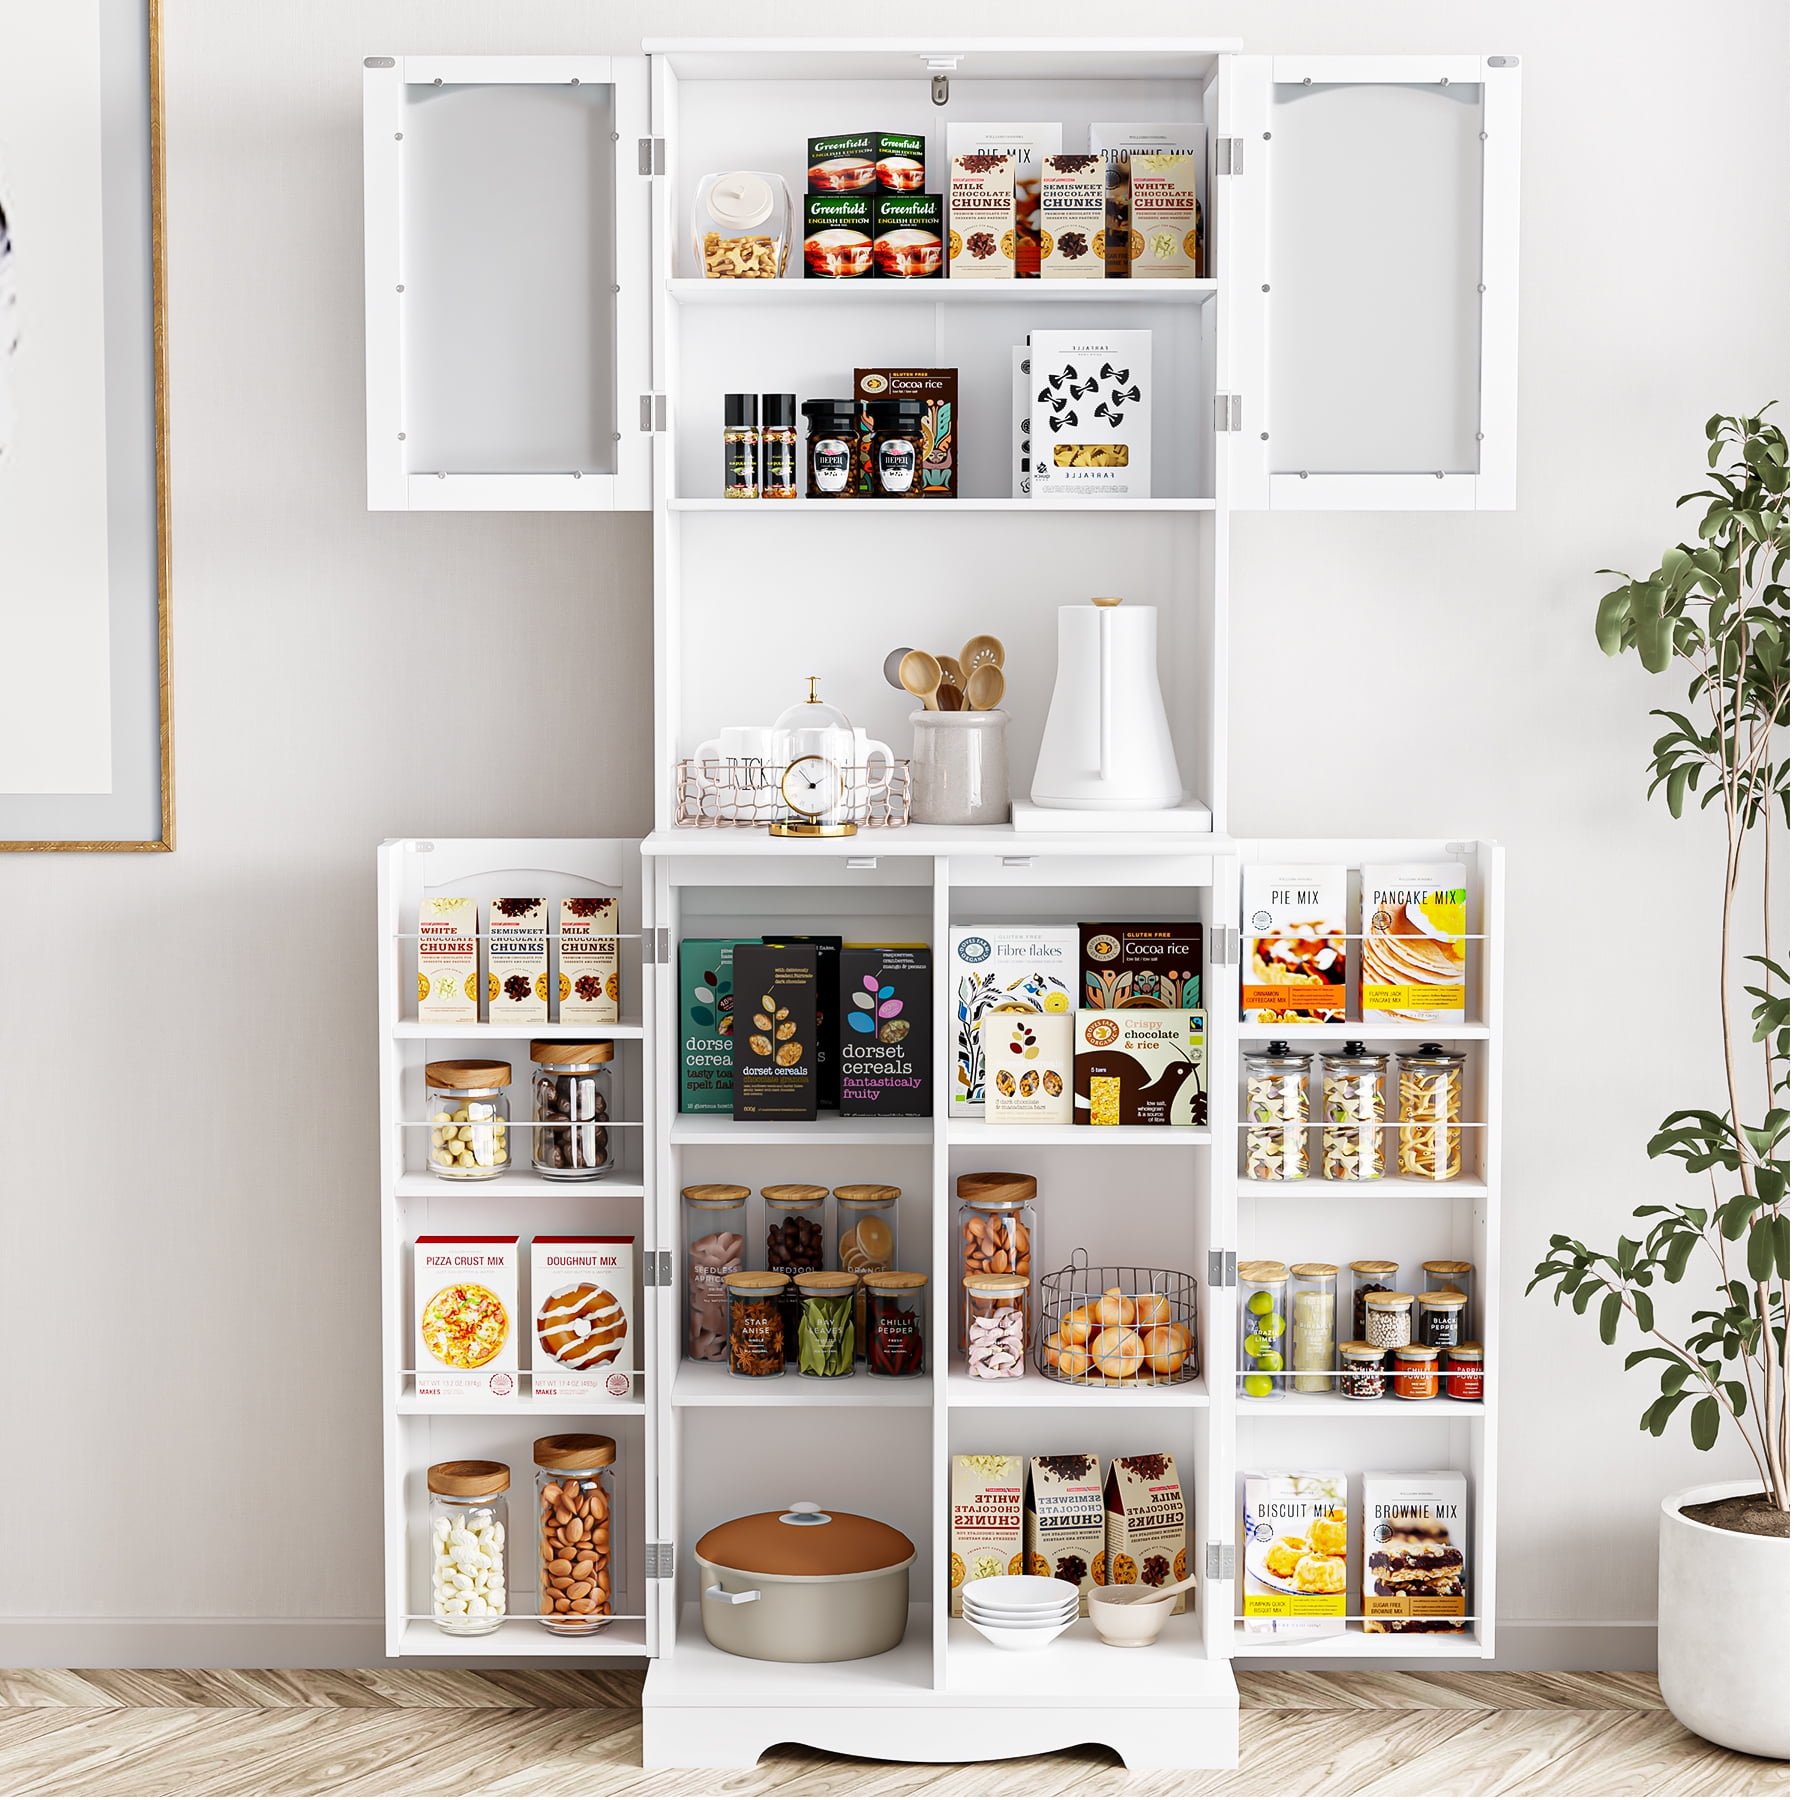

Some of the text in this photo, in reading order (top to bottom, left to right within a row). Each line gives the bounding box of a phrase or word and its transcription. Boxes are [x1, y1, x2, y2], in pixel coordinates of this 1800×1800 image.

[814, 138, 868, 152] Greenfield
[881, 138, 920, 150] Greenfield
[810, 202, 866, 215] Greenfield
[880, 202, 936, 215] Greenfield
[952, 199, 1010, 207] CHUNKS
[1043, 199, 1102, 207] CHUNKS
[1134, 199, 1194, 207] CHUNKS
[892, 380, 943, 389] Cocoa rice
[819, 456, 843, 465] ПЕРЕЦ
[885, 456, 909, 465] ПЕРЕЦ
[726, 757, 770, 790] TRICK
[1272, 890, 1319, 904] PIE MIX
[1374, 890, 1456, 904] PANCAKE MIX
[420, 944, 473, 952] CHUNKS
[490, 944, 544, 952] CHUNKS
[561, 944, 615, 952] CHUNKS
[960, 938, 975, 951] DOVES
[997, 944, 1062, 956] Fibre flakes
[1126, 942, 1189, 954] Cocoa rice
[962, 952, 988, 962] ORGANIC
[1087, 1020, 1117, 1036] DOVES FARM
[1125, 1019, 1163, 1030] Crispy
[1090, 1034, 1117, 1046] ORGANIC
[1124, 1030, 1179, 1039] chocolate
[686, 1037, 733, 1051] dorse
[1137, 1041, 1159, 1049] rice
[843, 1044, 905, 1058] dorset
[686, 1054, 733, 1066] cerea
[743, 1066, 773, 1076] dorset
[775, 1066, 808, 1075] cereals
[842, 1060, 912, 1074] cereals
[687, 1069, 715, 1079] tasty
[687, 1080, 733, 1091] spelt flak
[843, 1077, 921, 1088] fantasticaly
[843, 1089, 880, 1101] fruity
[426, 1256, 504, 1266] PIZZA CRUST MIX
[547, 1256, 617, 1266] DOUGHNUT MIX
[694, 1266, 738, 1274] SEEDLESS
[1258, 1504, 1335, 1517] BISCUIT MIX
[1375, 1504, 1457, 1518] BROWNIE MIX
